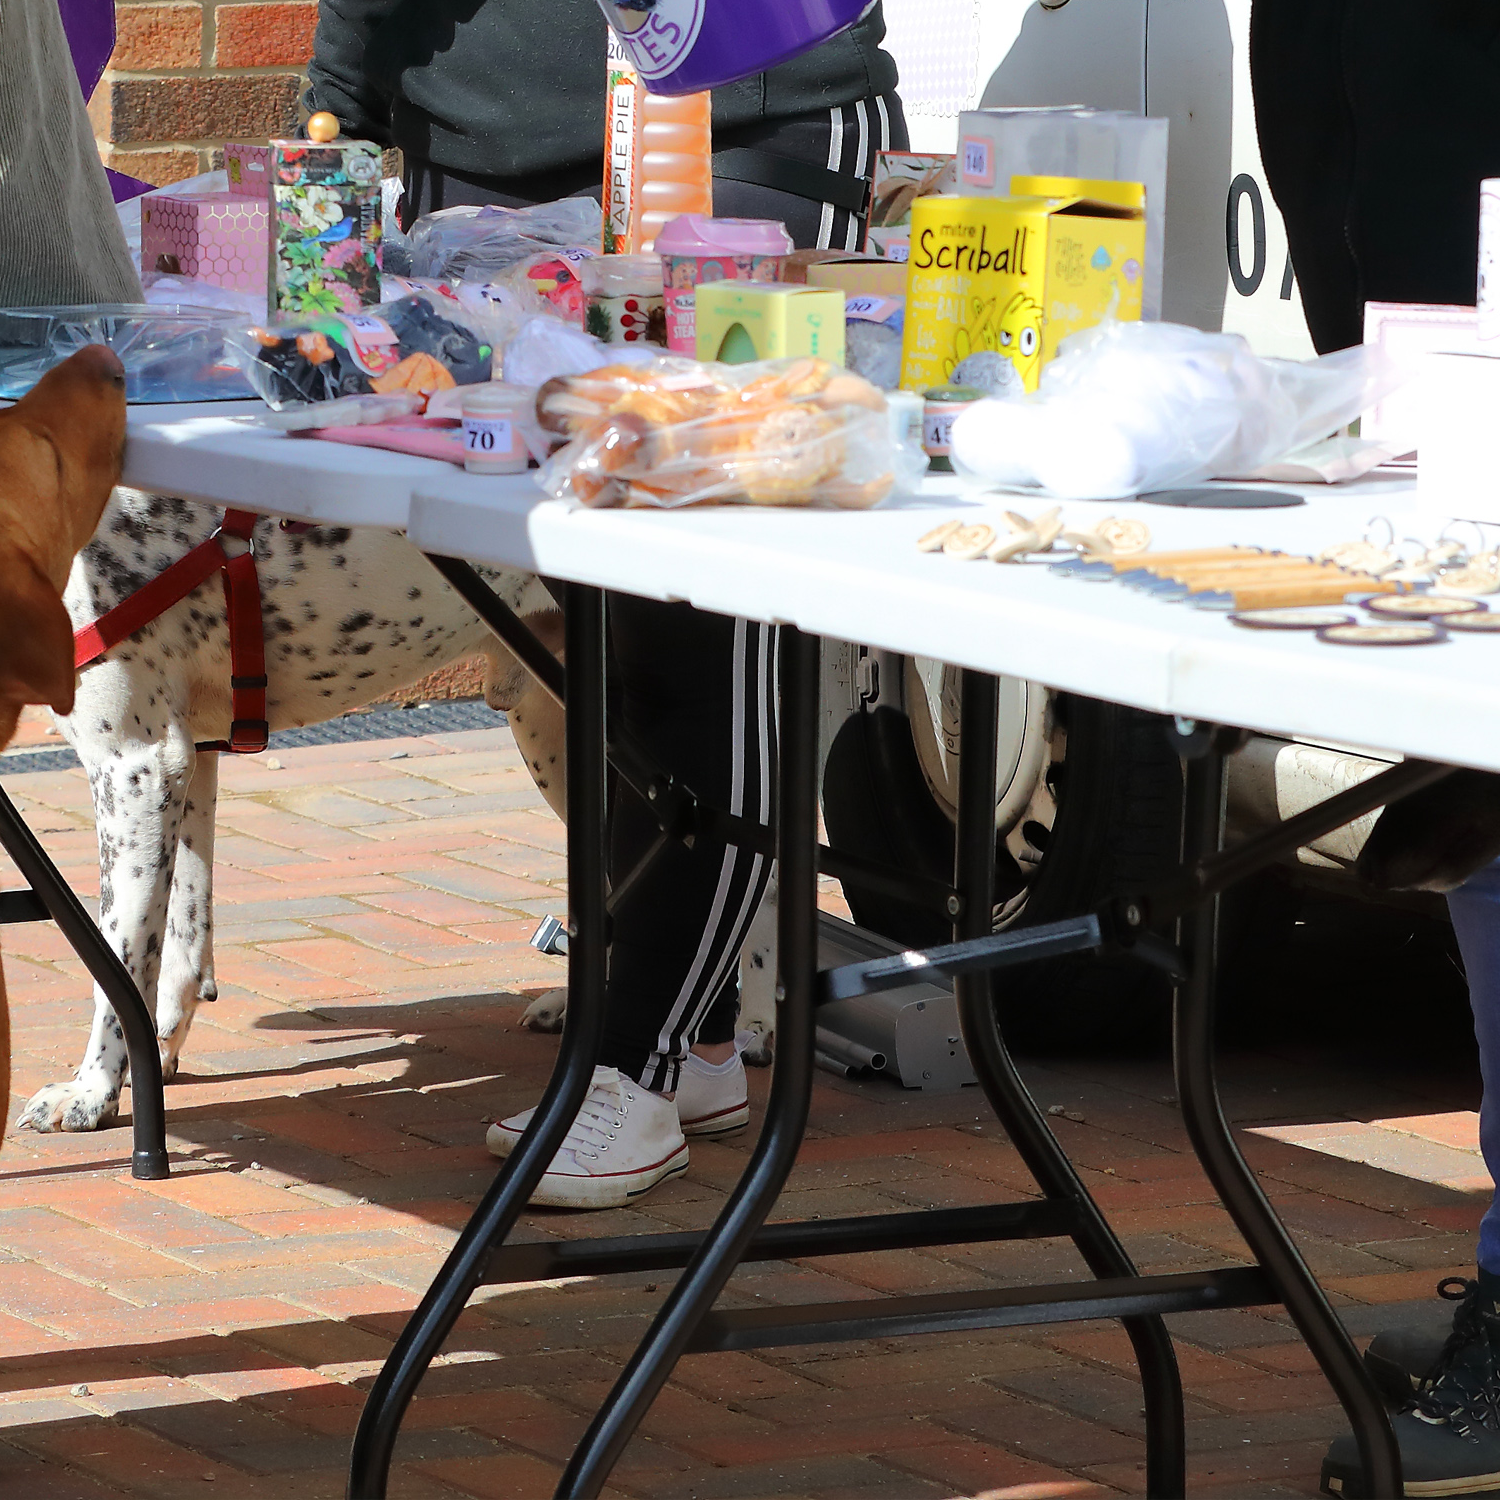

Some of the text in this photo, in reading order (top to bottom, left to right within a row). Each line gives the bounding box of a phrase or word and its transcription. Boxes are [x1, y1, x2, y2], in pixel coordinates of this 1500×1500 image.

[622, 13, 681, 66] TES
[612, 95, 630, 227] APPLE PIE
[940, 224, 976, 238] mitre
[468, 430, 495, 450] 70
